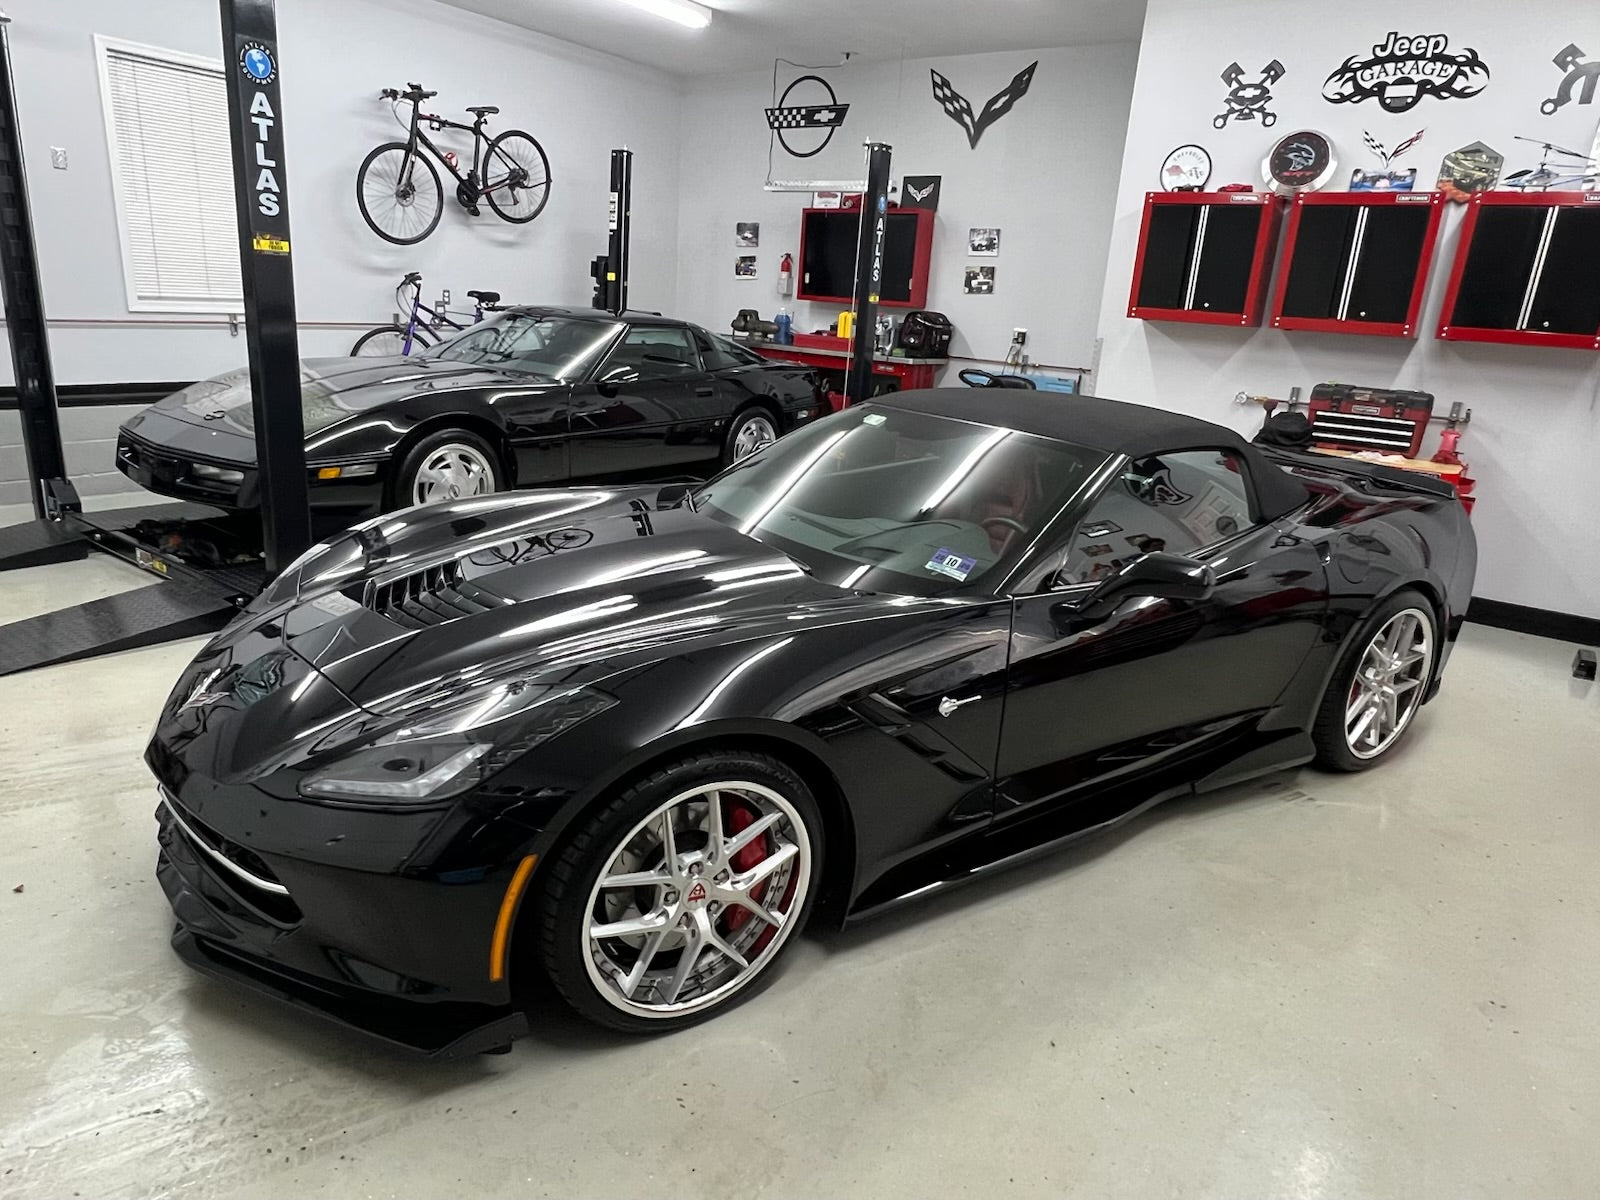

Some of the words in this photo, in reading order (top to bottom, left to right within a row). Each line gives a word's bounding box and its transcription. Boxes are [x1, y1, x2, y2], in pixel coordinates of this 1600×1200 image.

[244, 42, 270, 55] ATLAS
[1374, 33, 1447, 58] Jeep
[240, 61, 276, 85] EQUIPMENT
[1360, 60, 1454, 82] GARAGE
[250, 91, 281, 217] ATLAS
[872, 217, 884, 282] ATLAS
[945, 557, 958, 567] 10
